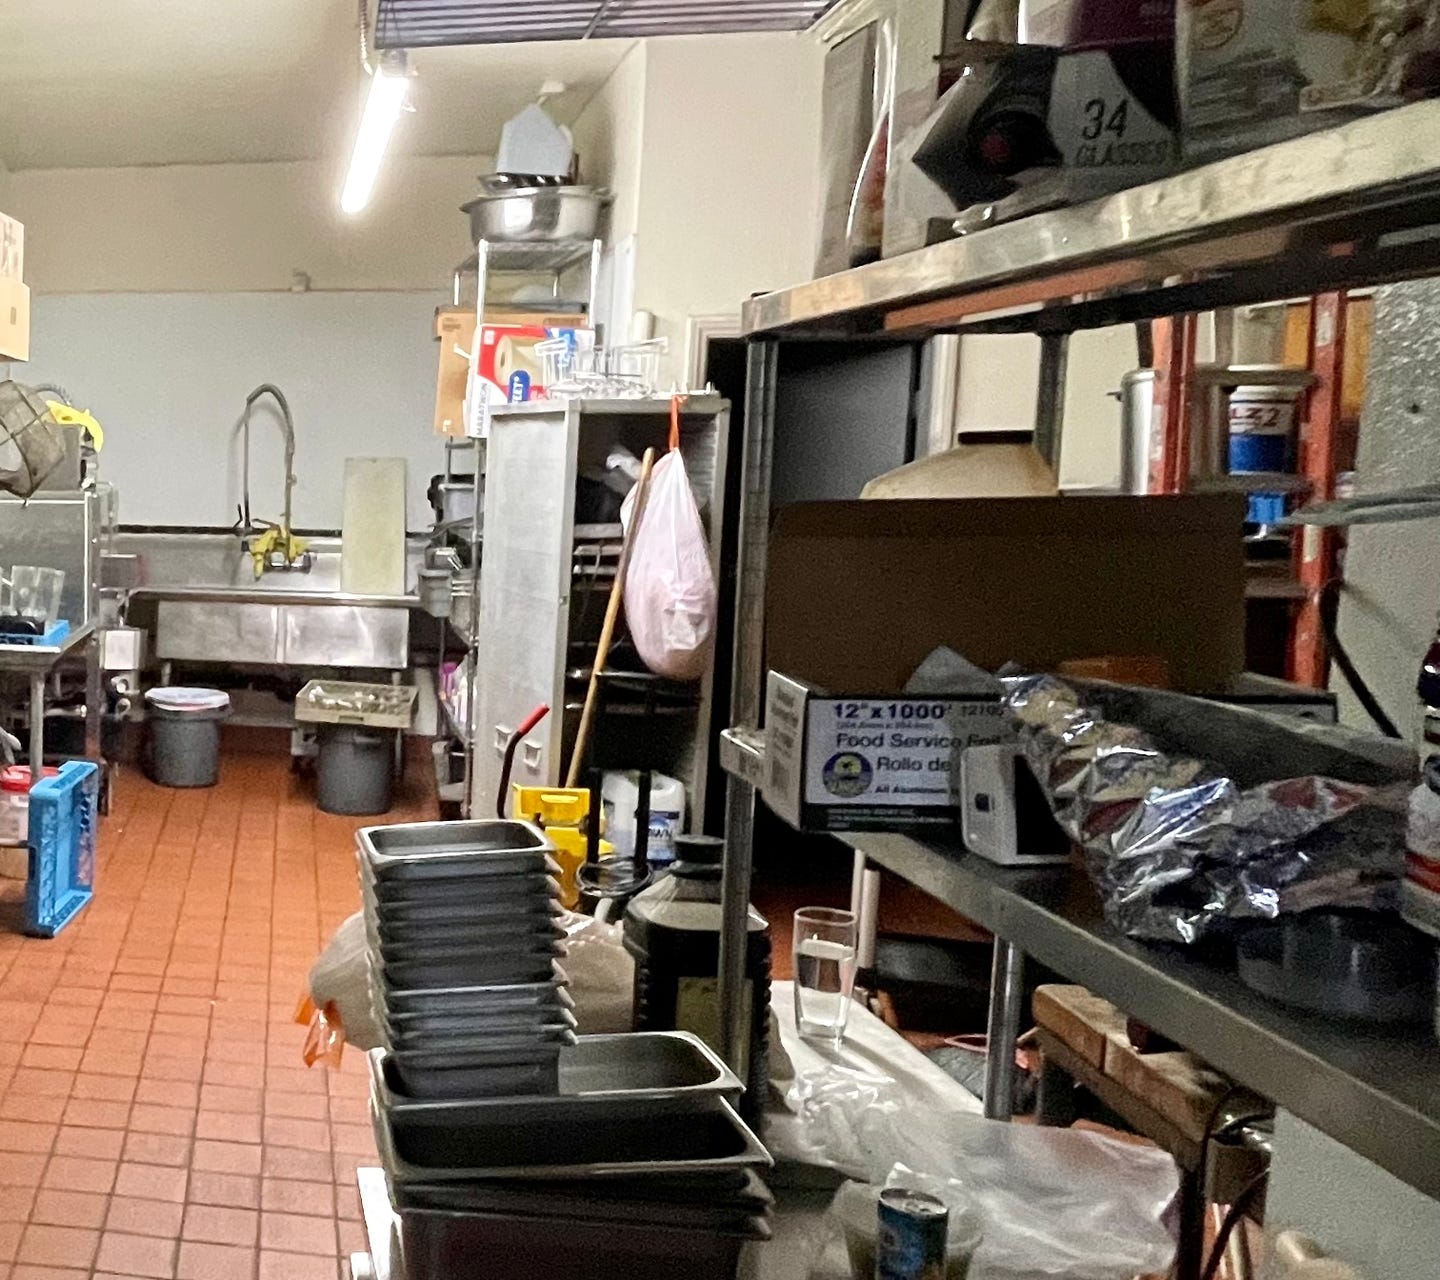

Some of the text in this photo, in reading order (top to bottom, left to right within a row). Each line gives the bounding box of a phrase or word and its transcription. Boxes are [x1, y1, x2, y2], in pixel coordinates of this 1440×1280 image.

[1083, 98, 1129, 140] 34
[870, 706, 883, 719] x
[836, 732, 884, 748] Food
[890, 733, 962, 748] Service
[876, 756, 952, 771] Rollo de
